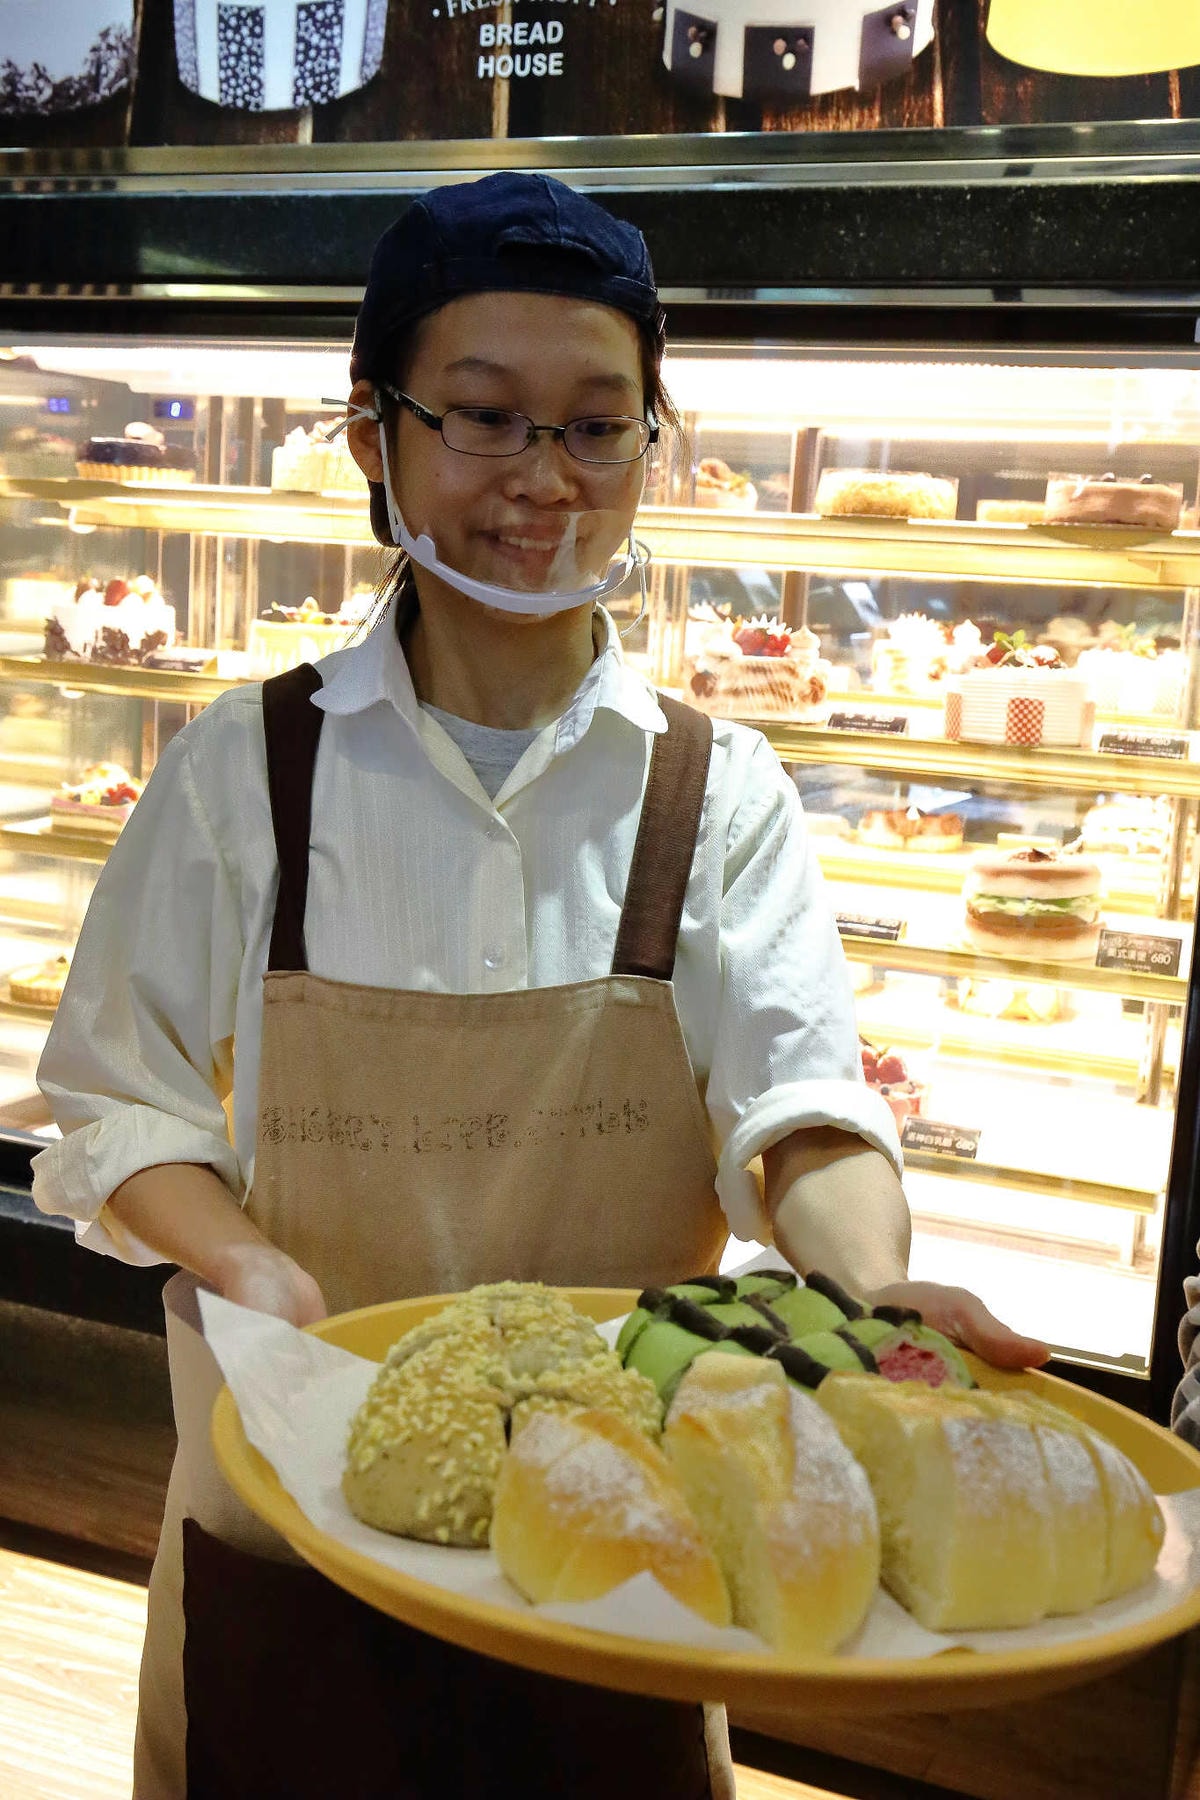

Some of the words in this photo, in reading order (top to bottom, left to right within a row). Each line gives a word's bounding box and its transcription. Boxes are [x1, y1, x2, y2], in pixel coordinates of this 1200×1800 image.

[479, 21, 564, 47] BREAD
[477, 52, 564, 79] HOUSE
[1150, 952, 1172, 965] 680
